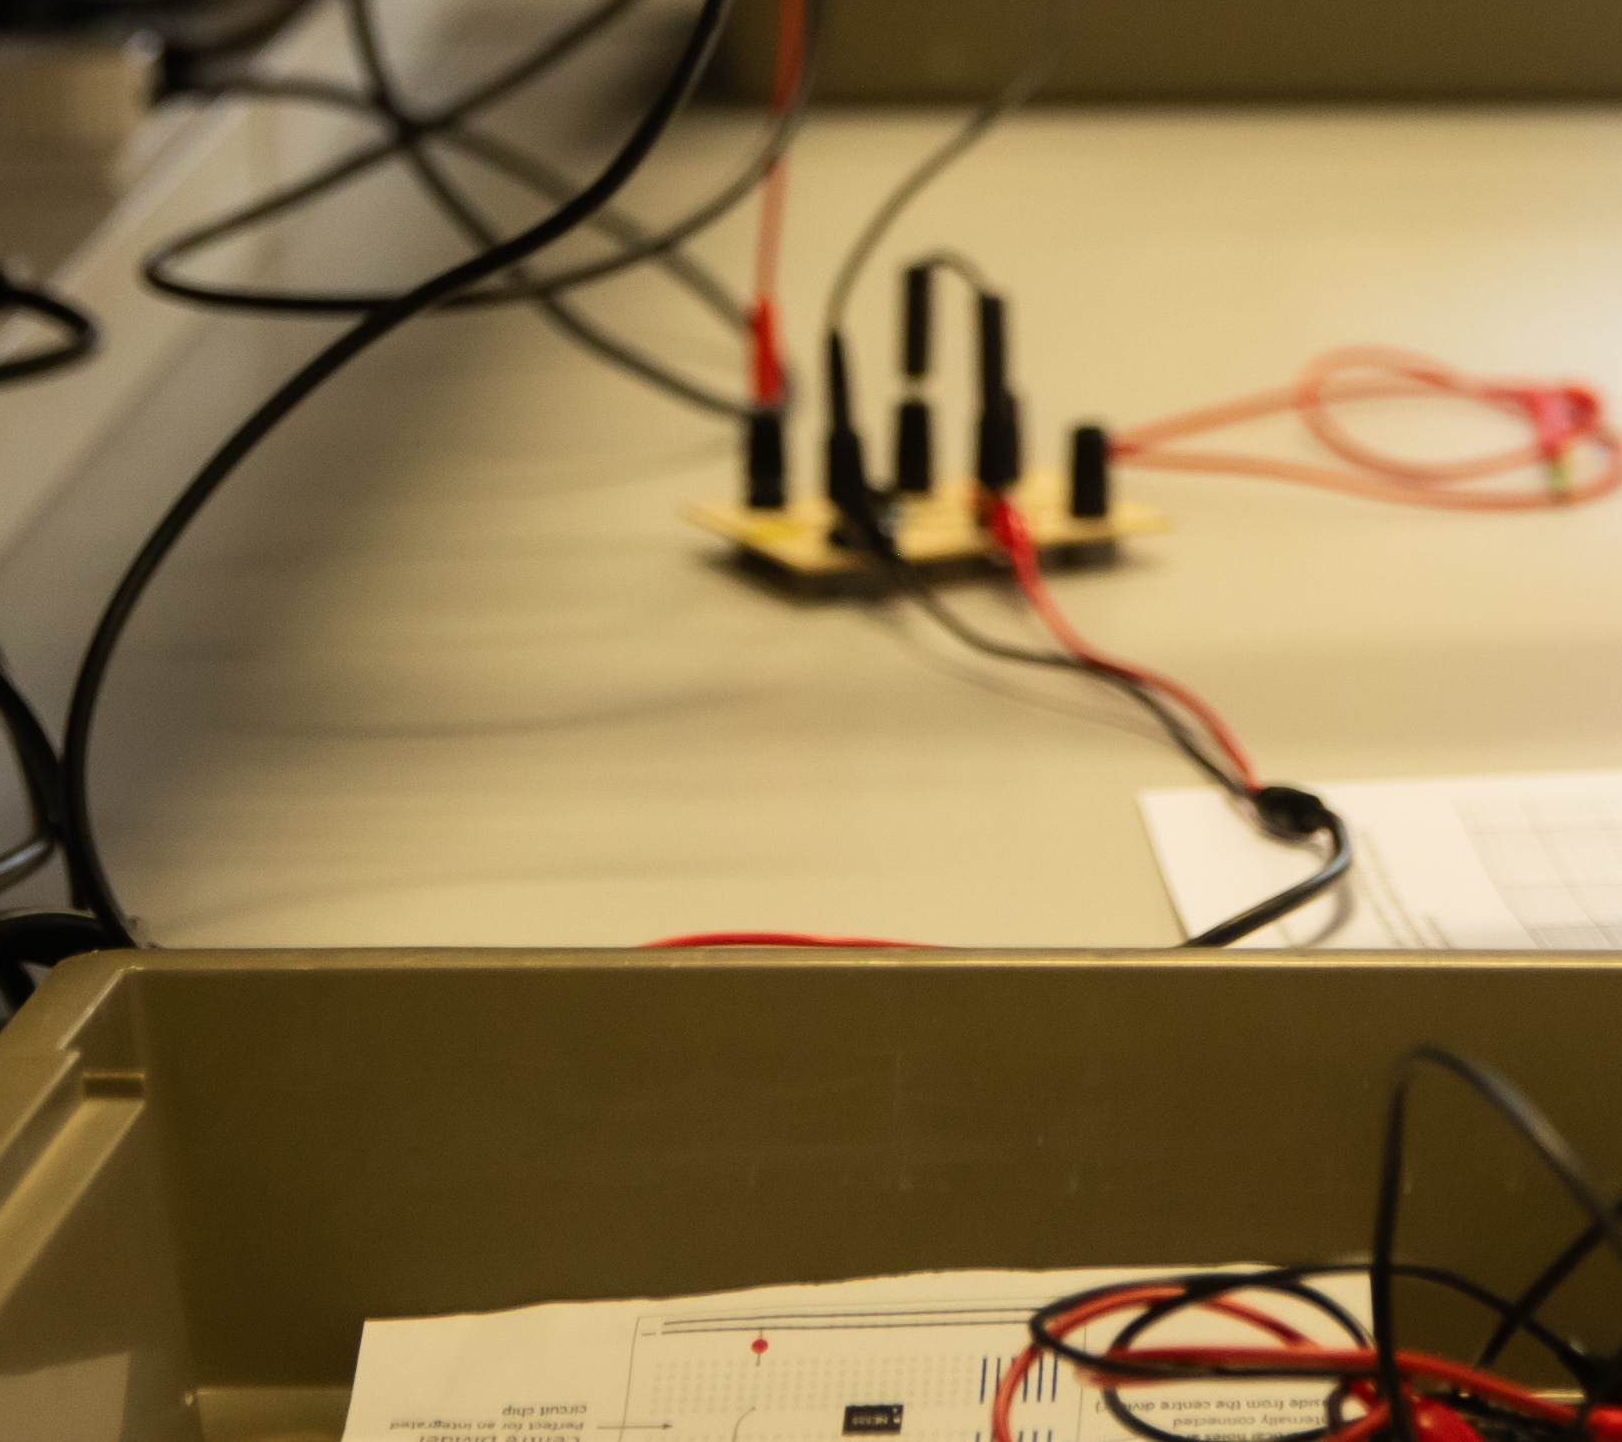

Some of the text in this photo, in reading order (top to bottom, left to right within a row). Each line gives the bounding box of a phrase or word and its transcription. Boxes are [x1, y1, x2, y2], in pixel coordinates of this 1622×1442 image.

[501, 1403, 588, 1418] circuit chip
[1159, 1399, 1212, 1412] centre
[1215, 1398, 1242, 1411] the
[1246, 1398, 1285, 1412] from
[390, 1419, 586, 1432] Perfect for an integrated
[1172, 1415, 1256, 1429] connected
